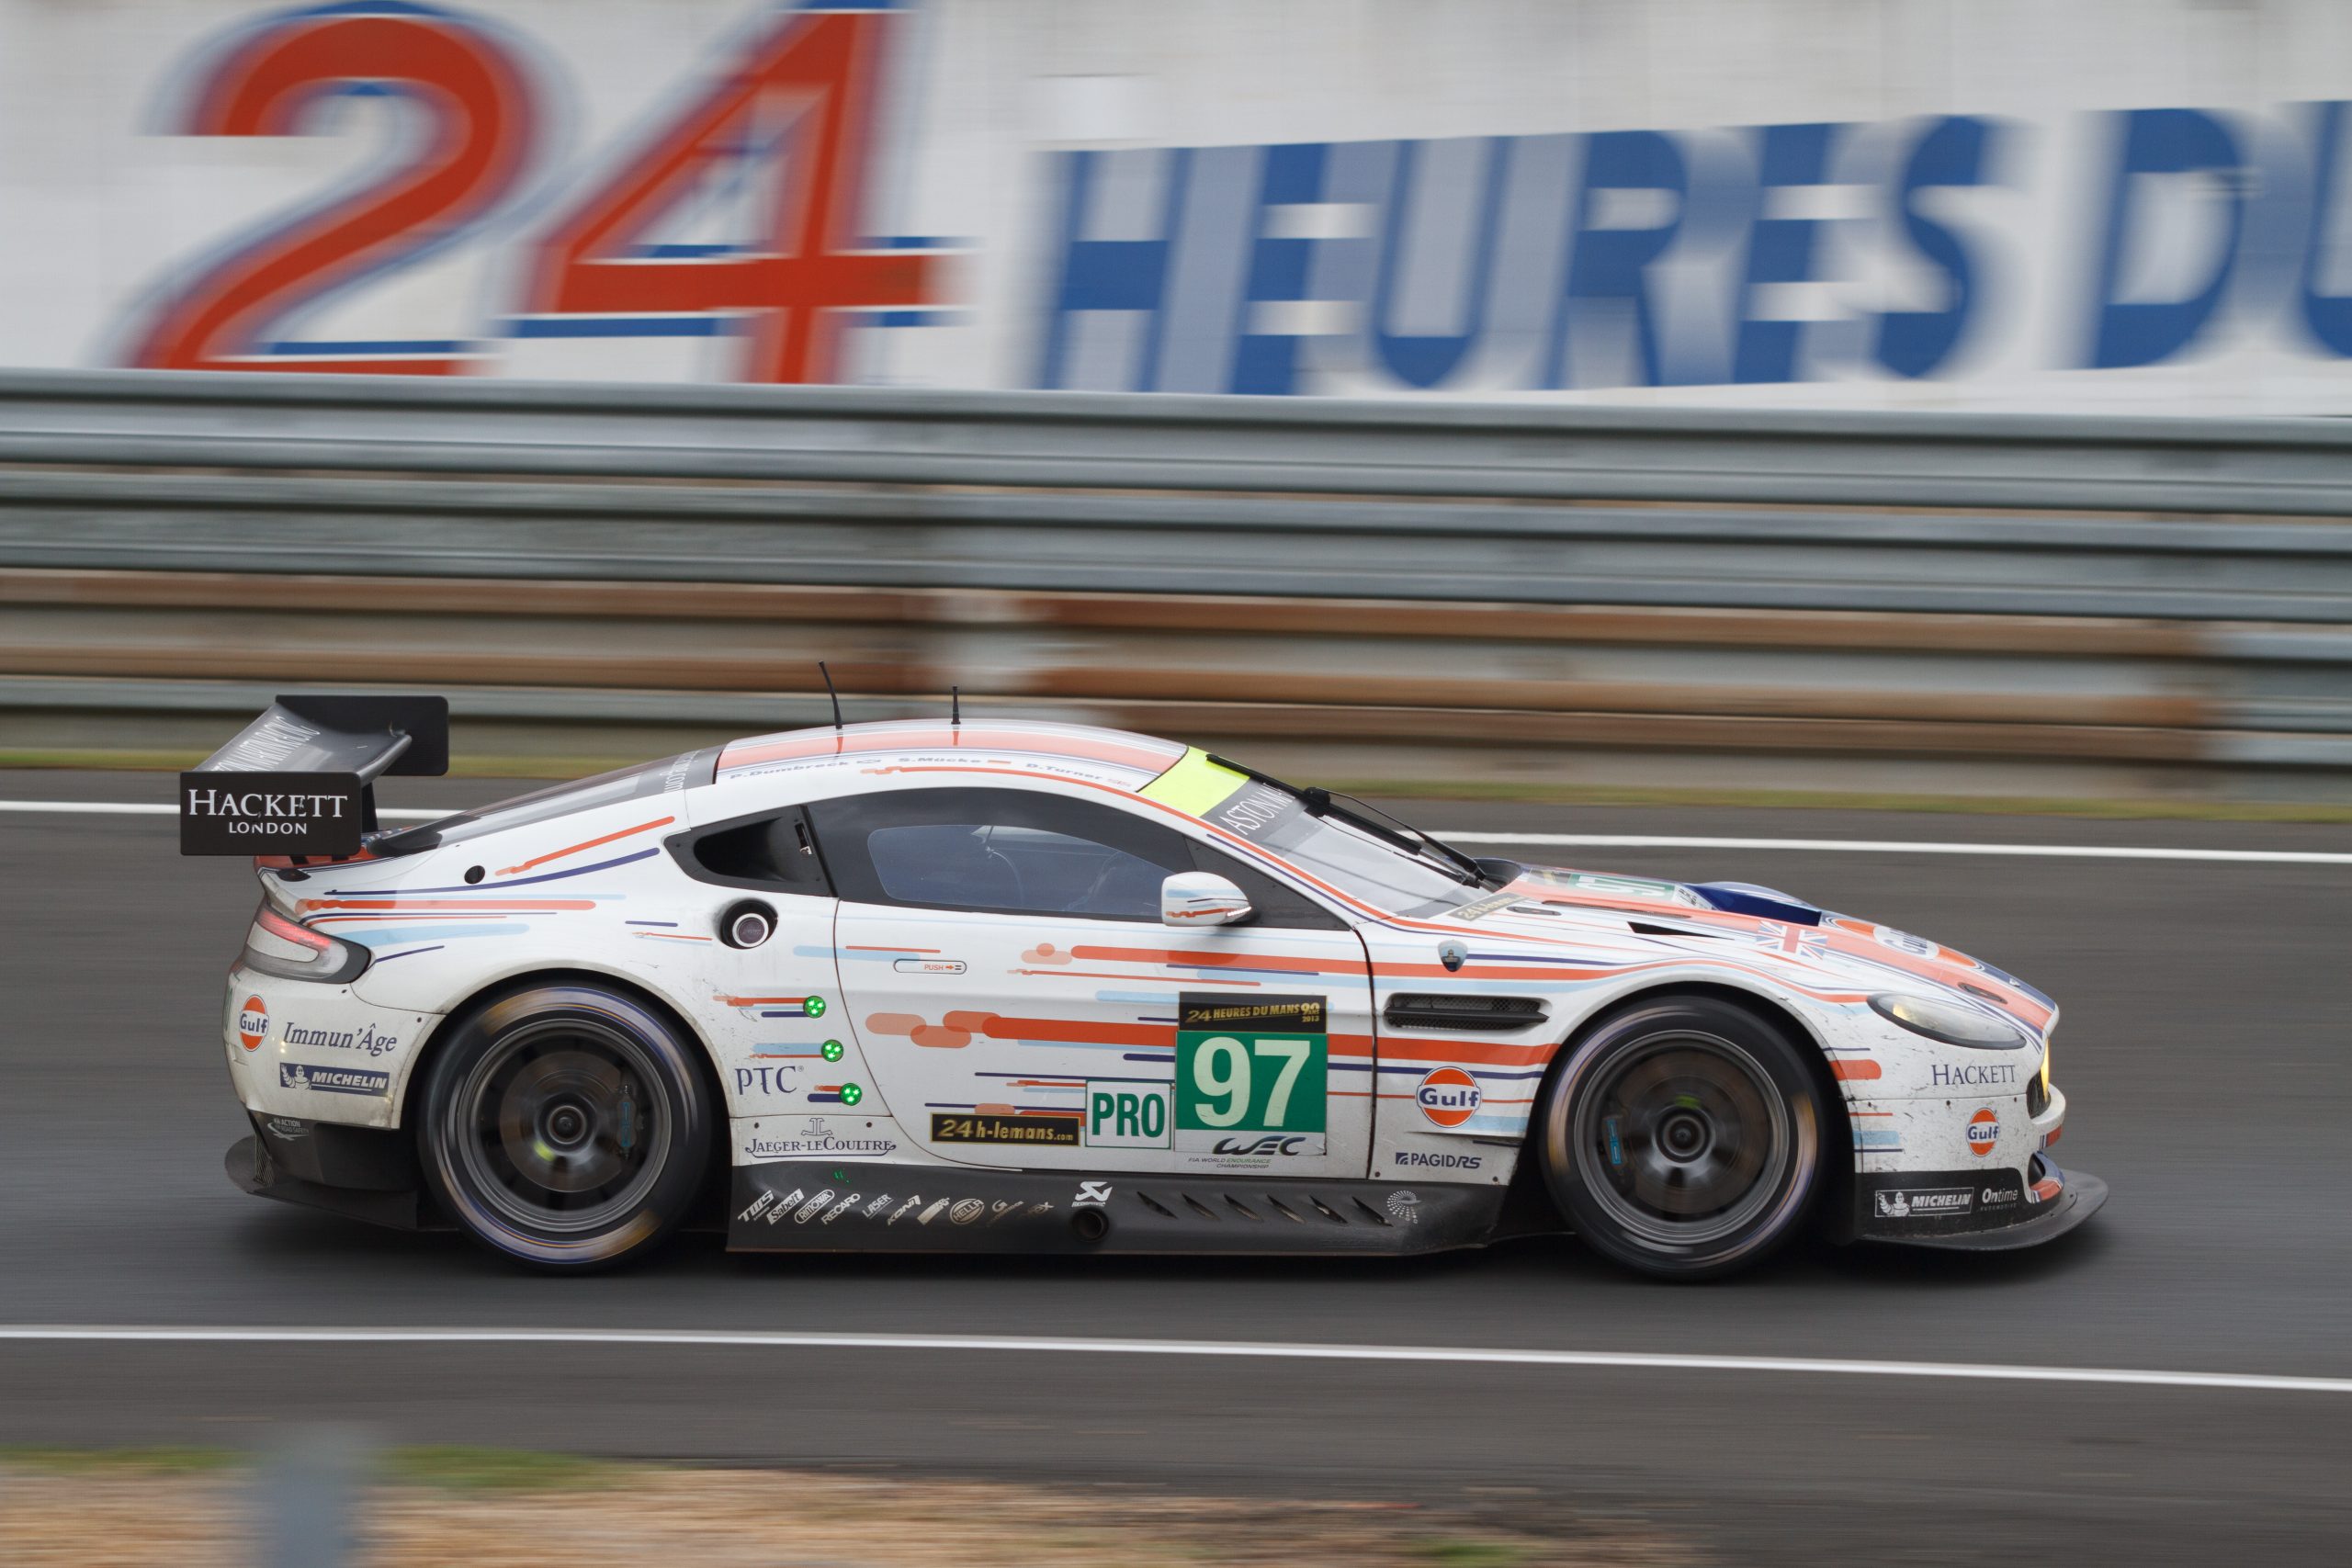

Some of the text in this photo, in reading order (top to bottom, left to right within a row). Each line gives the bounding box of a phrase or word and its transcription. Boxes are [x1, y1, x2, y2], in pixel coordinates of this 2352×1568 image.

[124, 0, 969, 384] 24
[1024, 112, 2017, 396] HEURES
[187, 788, 348, 818] HACKETT
[1219, 794, 1284, 836] ASTON
[229, 821, 308, 835] LONDON
[240, 1013, 268, 1033] Gulf
[1185, 1010, 1212, 1023] 24
[1213, 1007, 1250, 1019] HEURES
[1252, 1006, 1269, 1017] DU
[1269, 1004, 1301, 1016] MANS
[311, 1071, 388, 1089] MICHELIN
[1194, 1036, 1311, 1128] 97
[1931, 1064, 2017, 1086] HACKETT
[1419, 1087, 1479, 1107] Gulf
[1091, 1093, 1166, 1138] PRO
[1967, 1125, 1999, 1140] Gulf
[1212, 1135, 1306, 1156] WEC
[770, 1191, 801, 1222] Sabelt
[798, 1191, 831, 1221] RIMOWA
[862, 1192, 893, 1219] LASER
[1911, 1193, 1972, 1207] MICHELIN
[1982, 1188, 2018, 1203] Ontime
[820, 1193, 861, 1225] RECARO
[952, 1199, 985, 1222] HELLA
